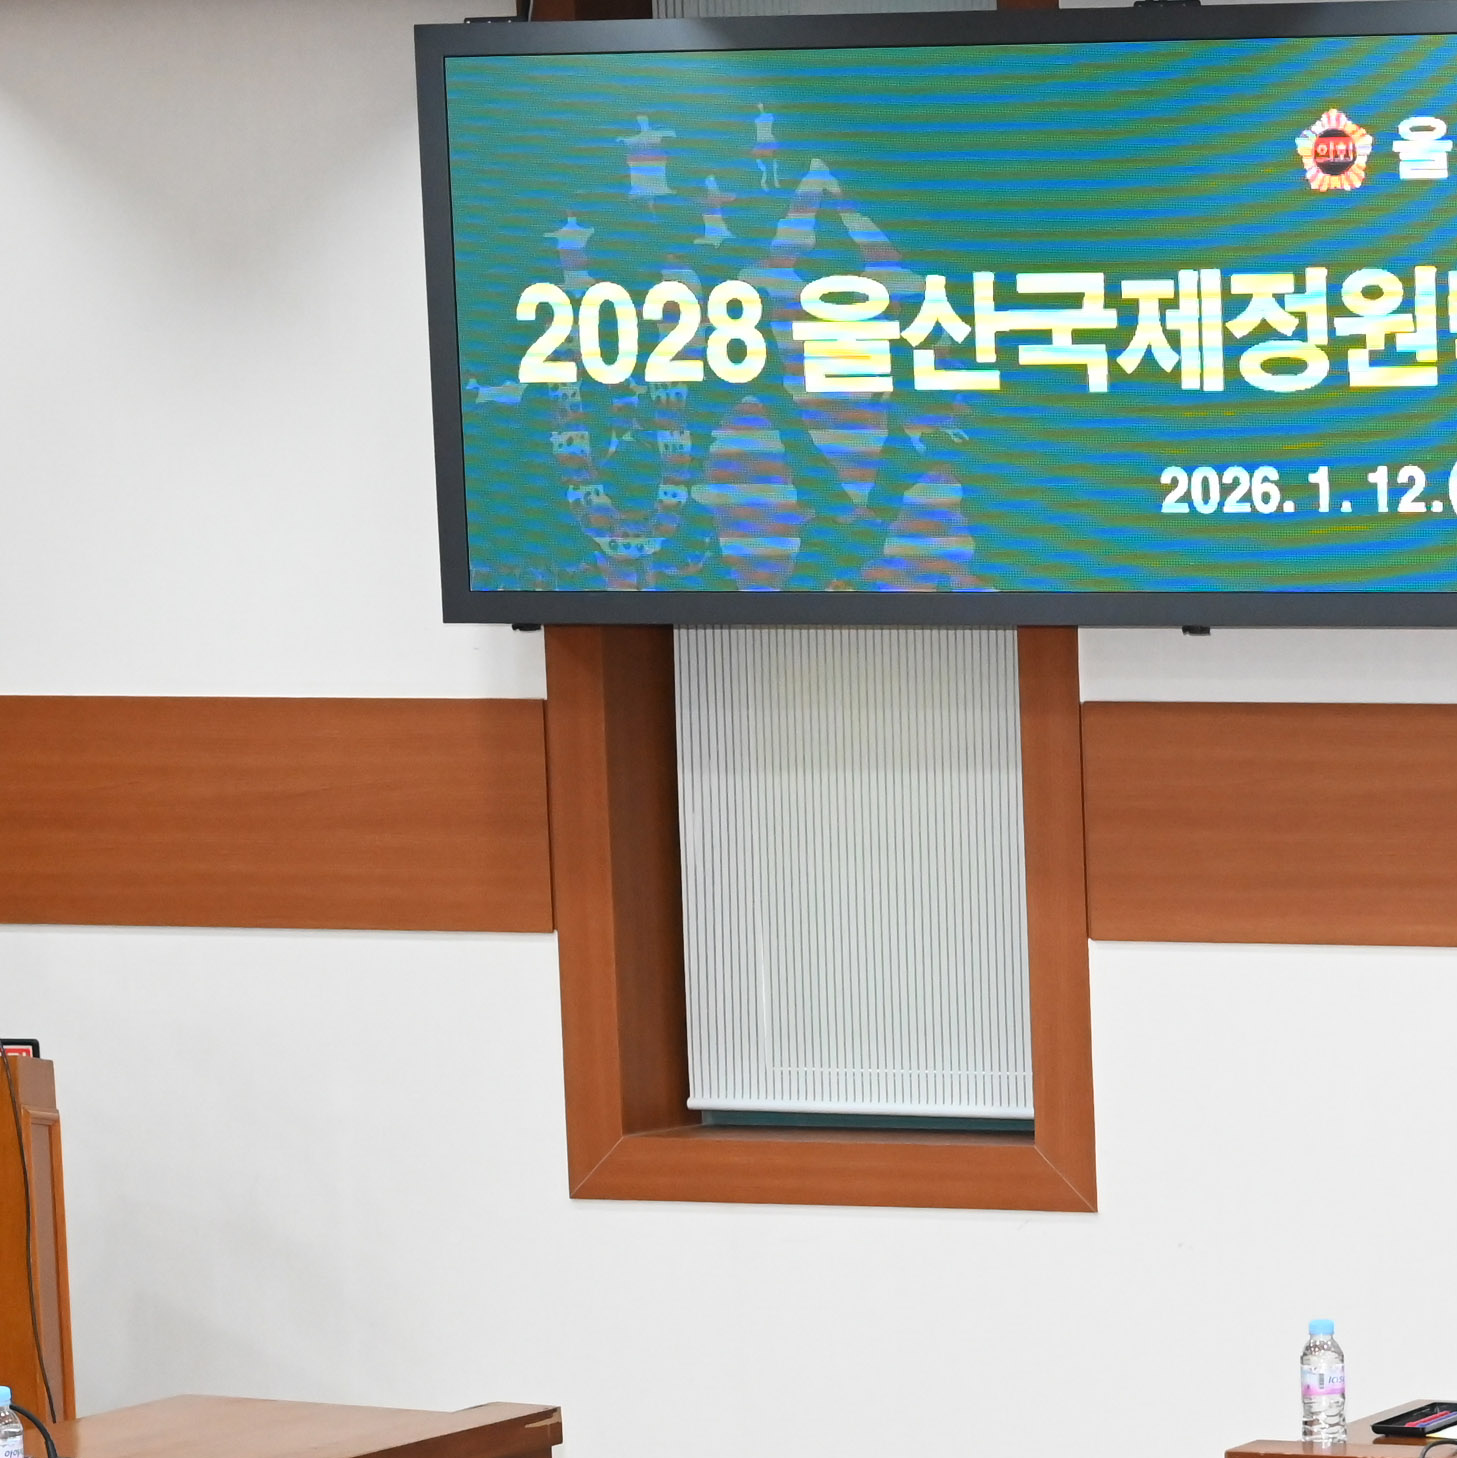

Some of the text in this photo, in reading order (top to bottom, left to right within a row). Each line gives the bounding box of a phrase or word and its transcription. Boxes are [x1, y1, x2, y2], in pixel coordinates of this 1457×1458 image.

[515, 280, 768, 386] 2028
[1159, 466, 1297, 516] 2026.
[1307, 465, 1353, 514] 1.
